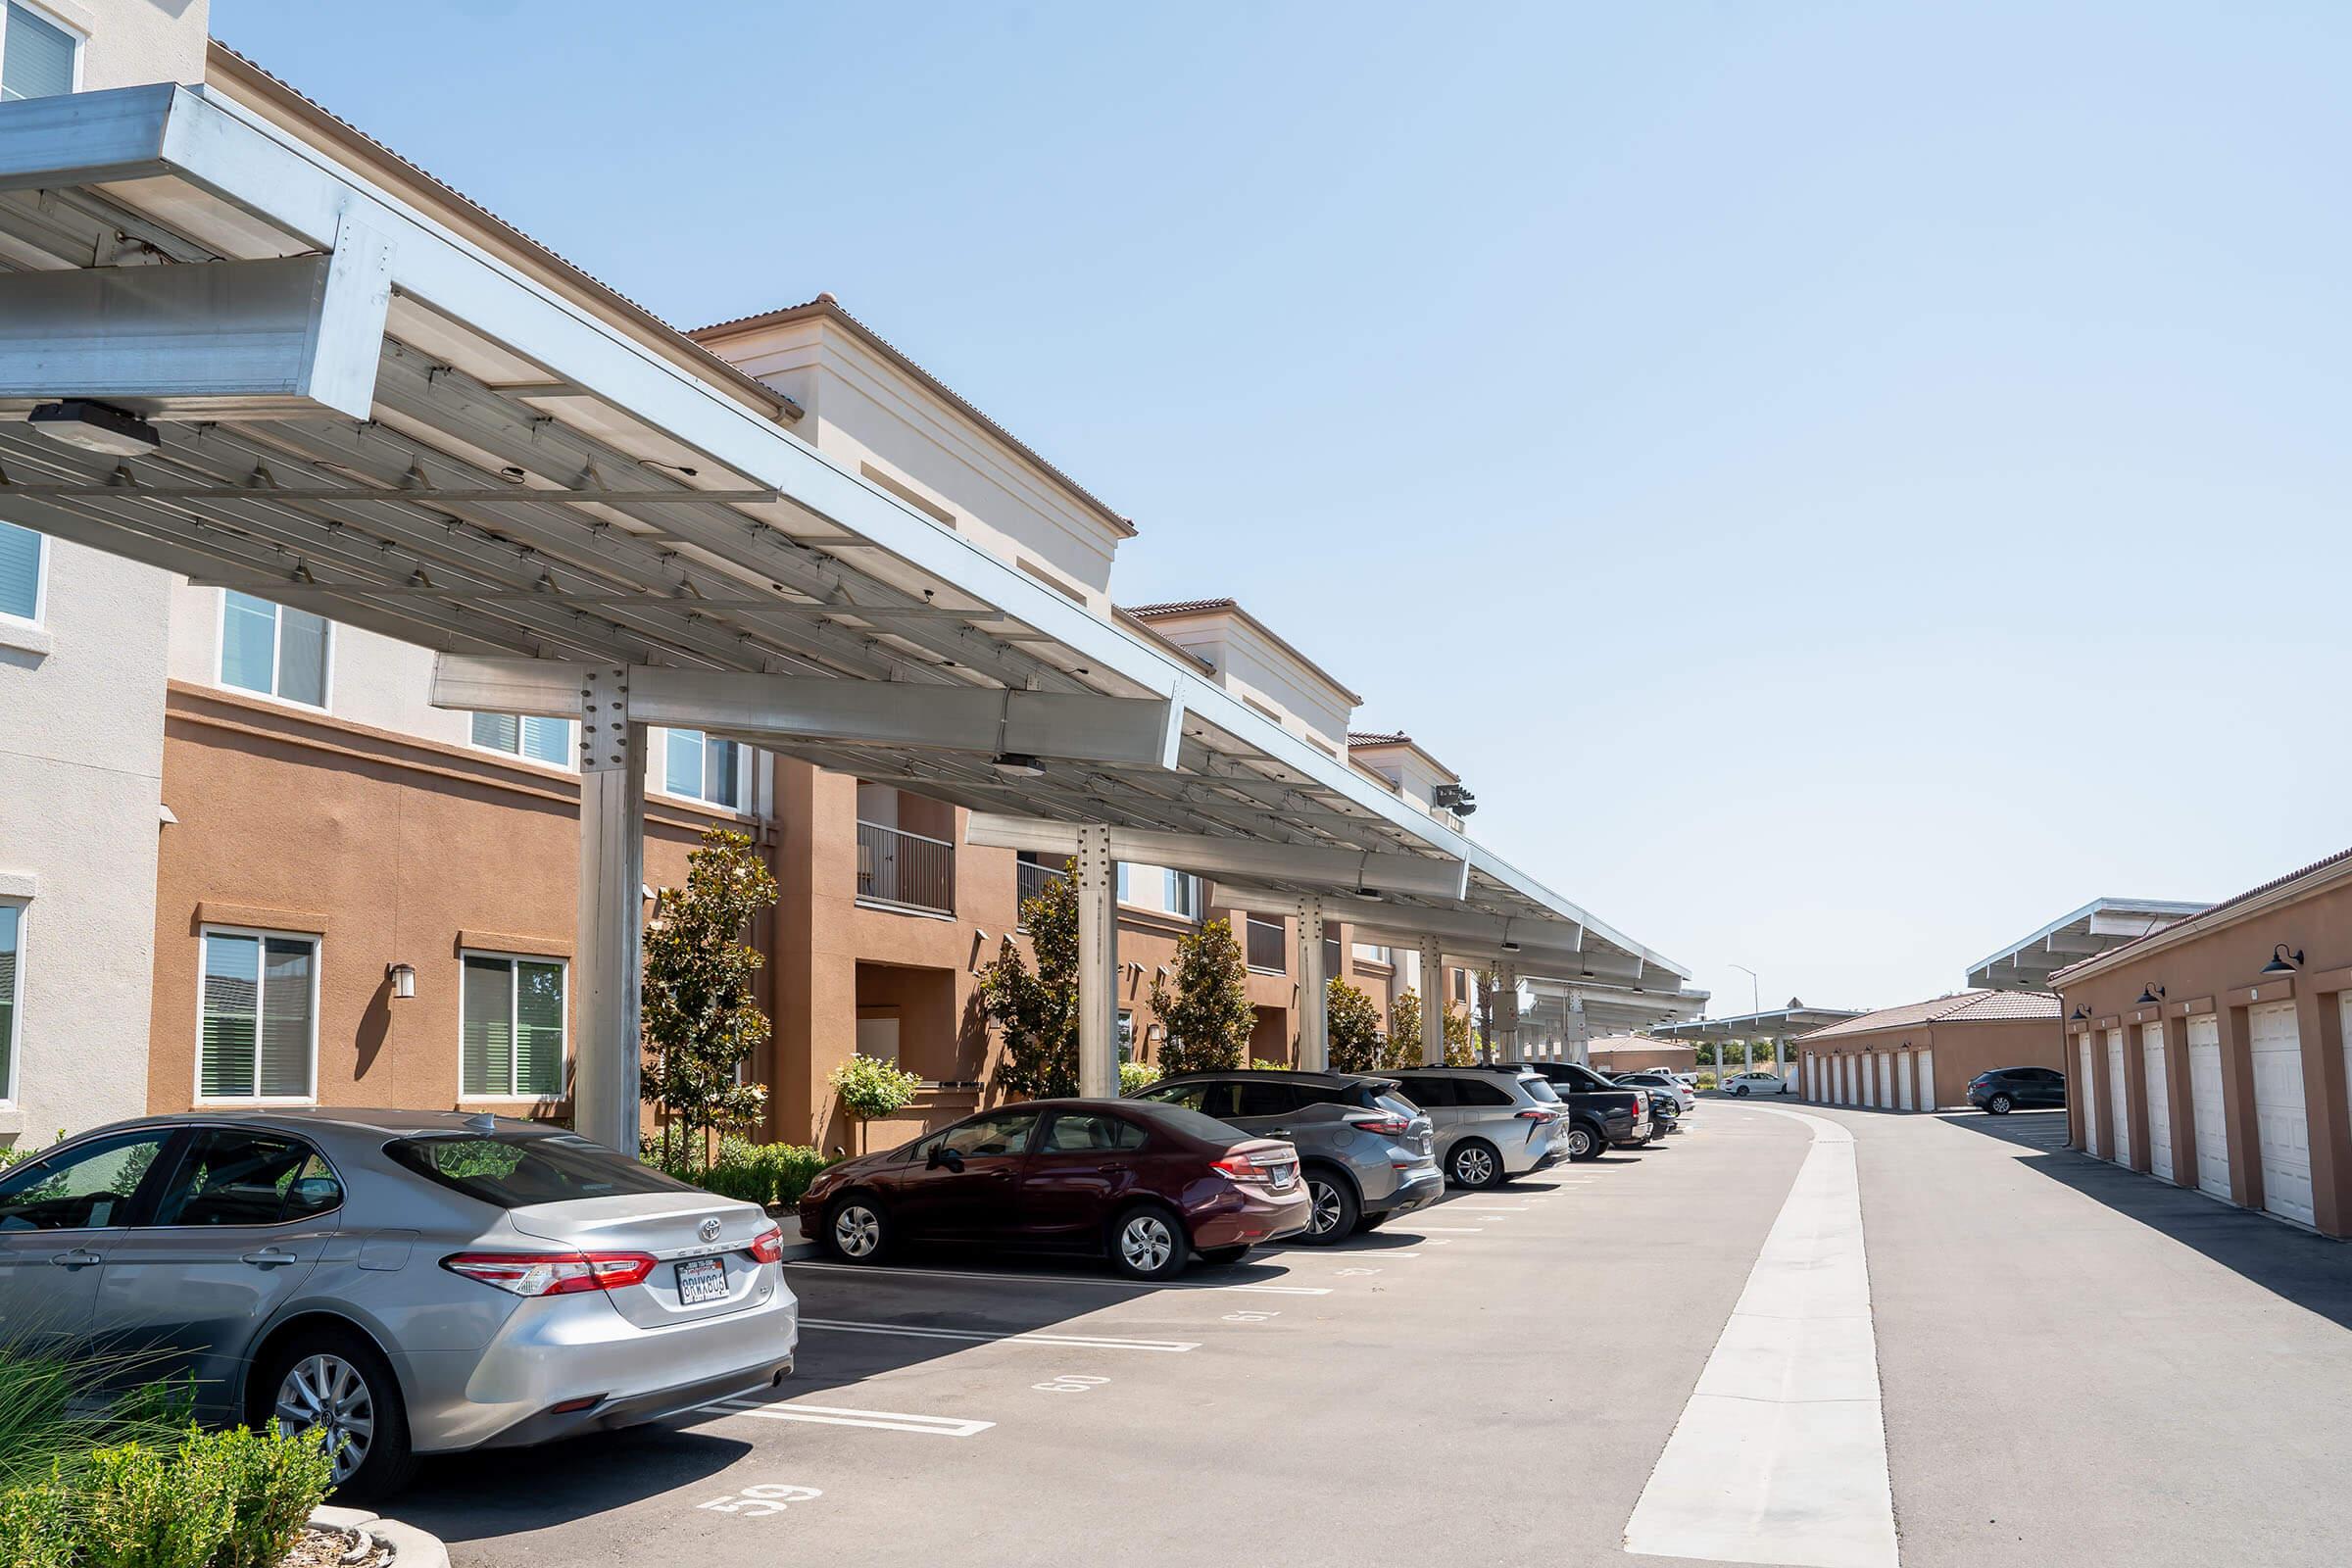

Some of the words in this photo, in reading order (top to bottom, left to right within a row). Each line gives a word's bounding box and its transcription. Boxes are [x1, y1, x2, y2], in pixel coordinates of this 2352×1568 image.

[682, 1273, 725, 1298] 8RWX806
[1031, 1374, 1110, 1393] 60
[695, 1483, 823, 1517] 59
